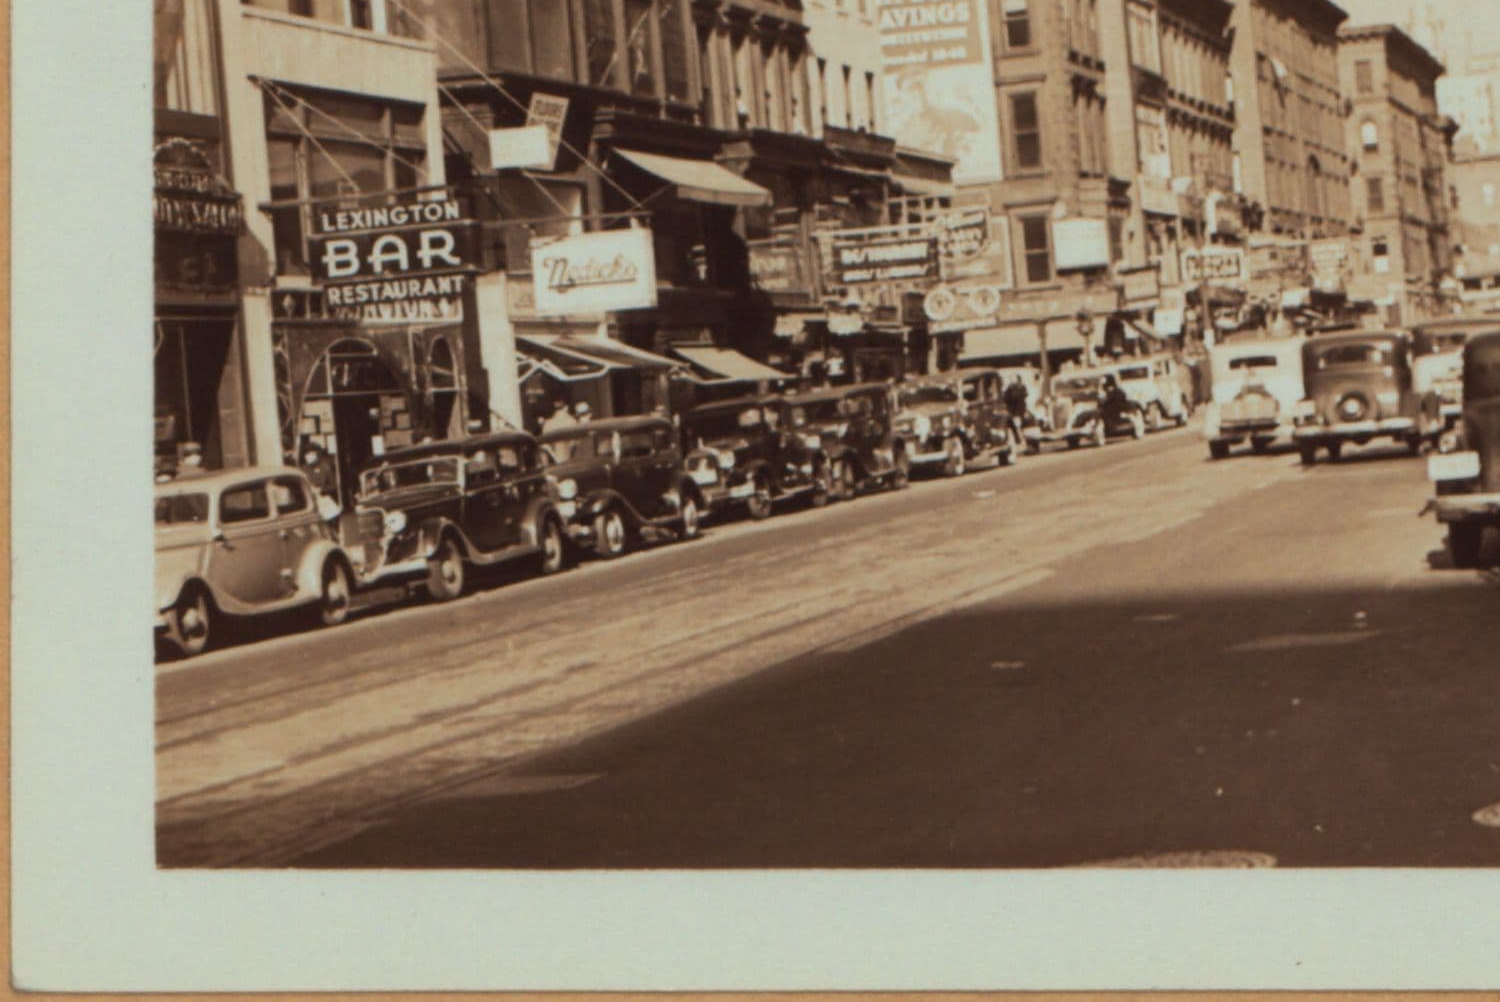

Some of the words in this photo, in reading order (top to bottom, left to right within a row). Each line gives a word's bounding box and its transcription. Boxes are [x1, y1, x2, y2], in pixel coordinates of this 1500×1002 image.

[322, 201, 460, 231] LEXINGTON
[322, 230, 461, 277] BAR
[327, 275, 464, 305] RESTAURANT
